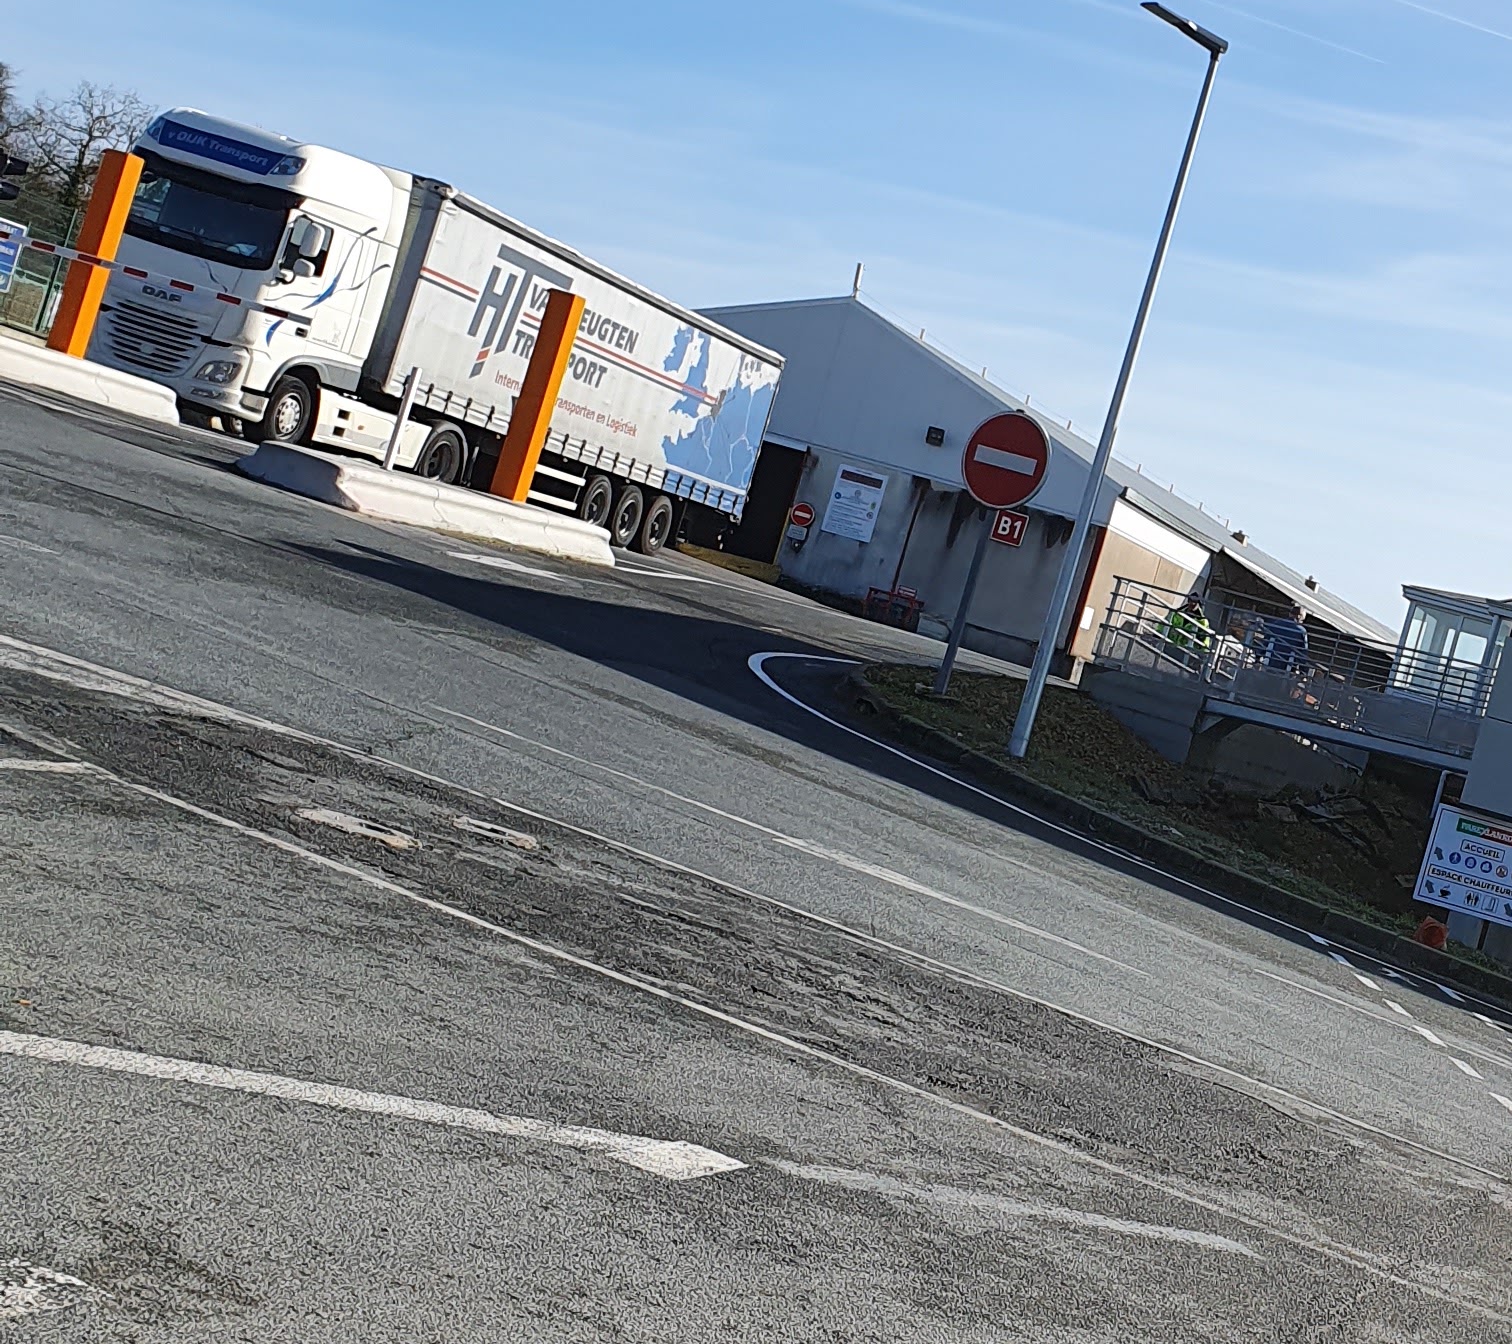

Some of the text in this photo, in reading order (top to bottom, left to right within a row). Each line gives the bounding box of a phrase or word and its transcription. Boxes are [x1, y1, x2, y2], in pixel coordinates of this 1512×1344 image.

[208, 139, 270, 167] Transport
[142, 284, 183, 303] DAF
[577, 307, 640, 355] EUGTEN
[554, 397, 597, 421] ransporten
[997, 515, 1023, 539] B1
[1464, 844, 1501, 859] ACCUEIL
[1430, 867, 1463, 883] ESPACE
